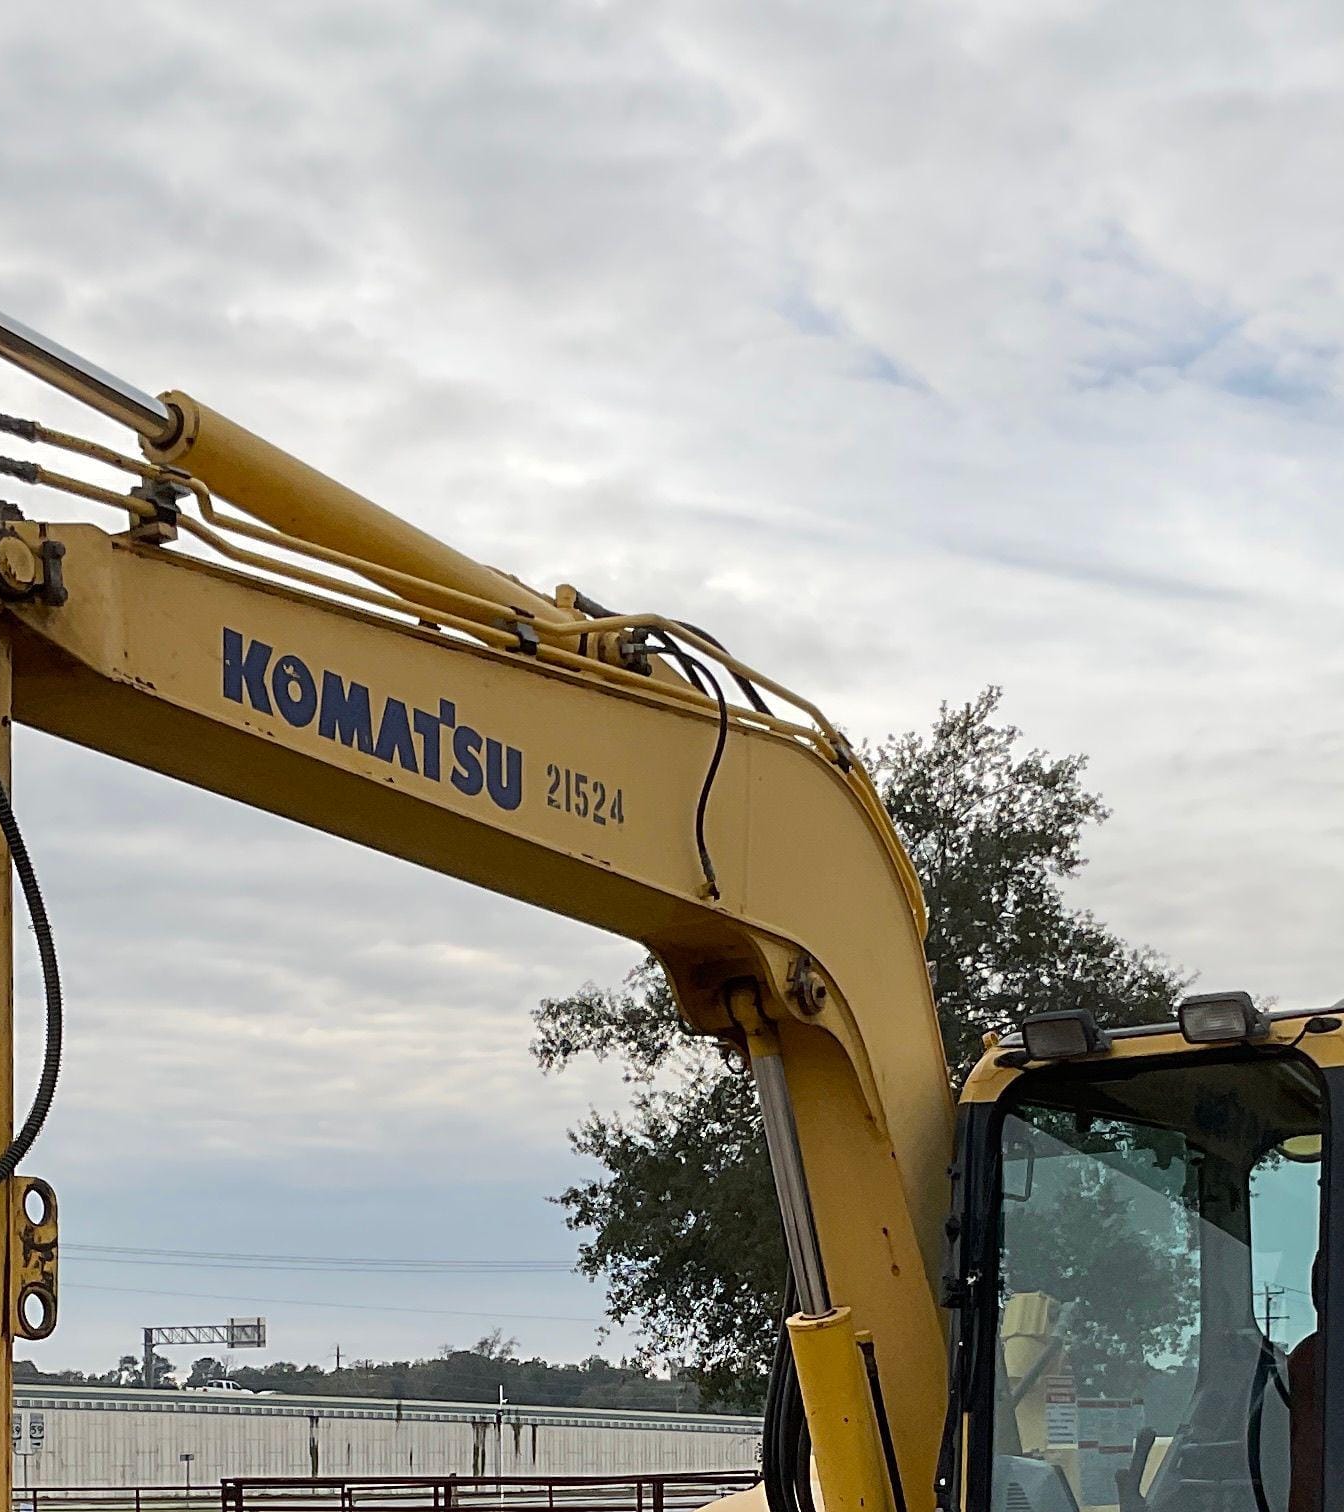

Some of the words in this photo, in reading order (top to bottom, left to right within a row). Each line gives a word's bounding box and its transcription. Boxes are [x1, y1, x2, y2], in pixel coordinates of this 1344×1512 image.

[223, 626, 523, 811] KOMATSU
[547, 764, 624, 826] 21524
[30, 1425, 44, 1435] 59
